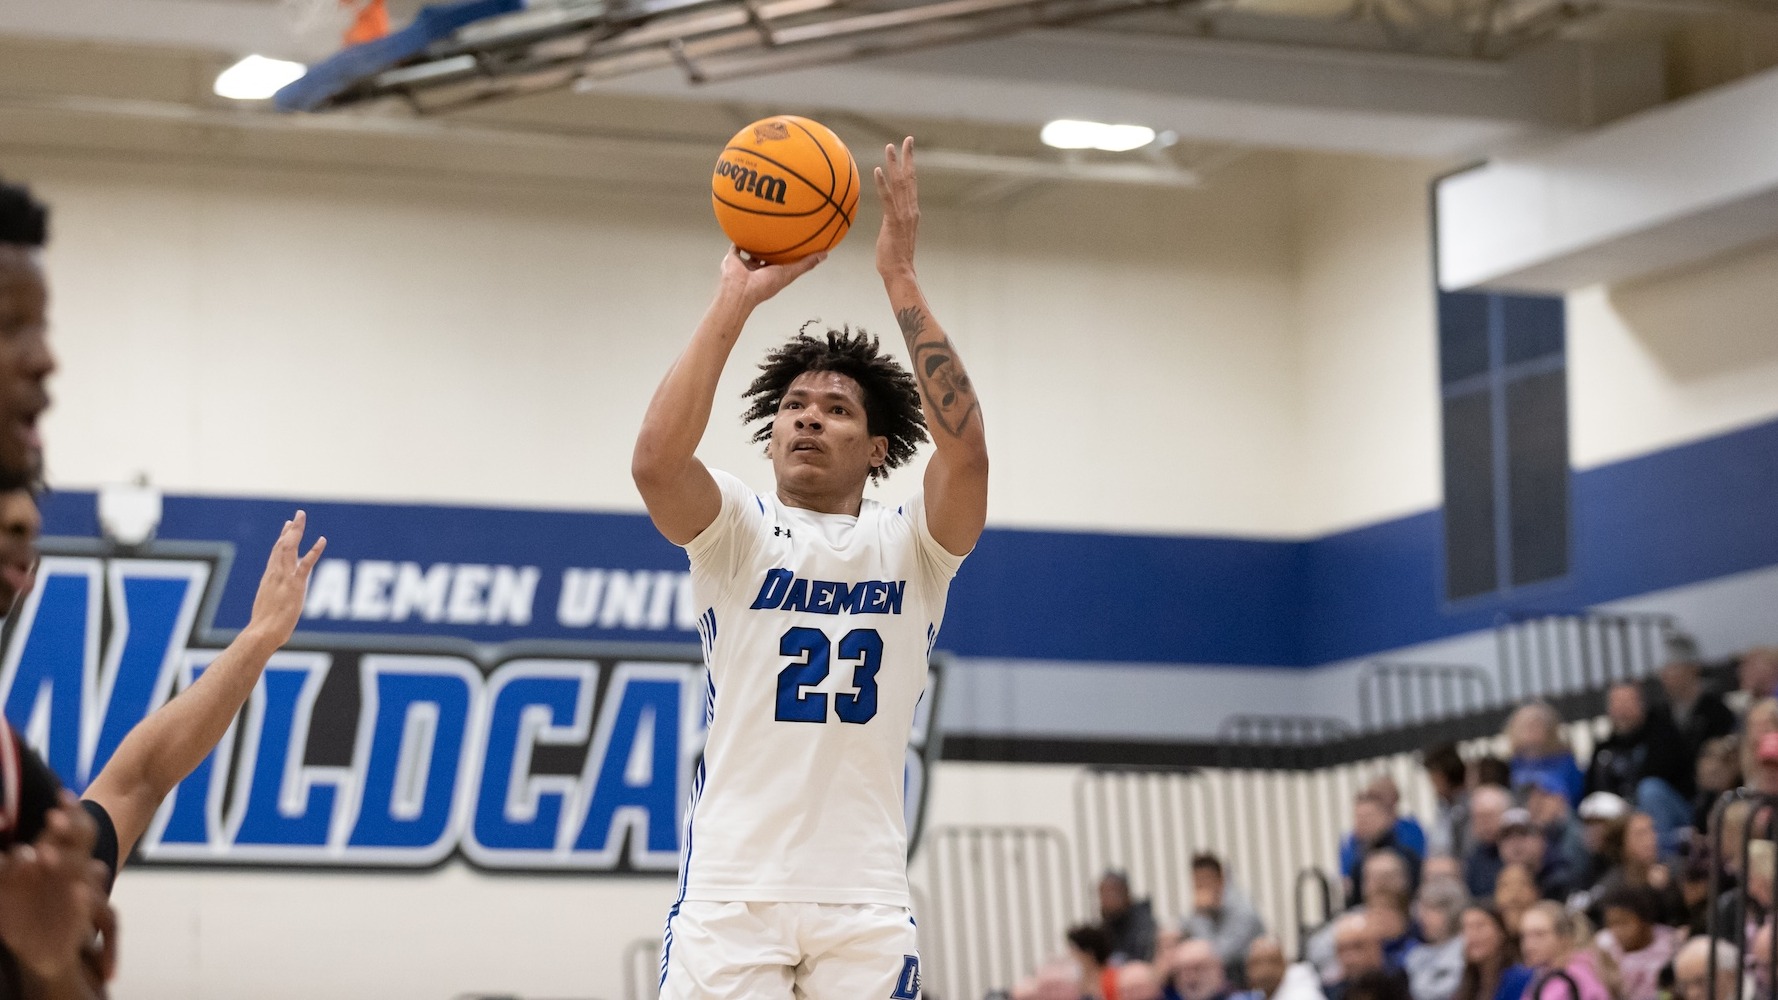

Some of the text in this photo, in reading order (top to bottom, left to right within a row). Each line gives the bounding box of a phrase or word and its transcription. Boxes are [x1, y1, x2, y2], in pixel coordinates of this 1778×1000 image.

[716, 160, 787, 205] Wilson
[302, 558, 541, 627] AEMEN
[750, 568, 906, 614] DAEMEN
[775, 626, 884, 725] 23
[0, 556, 928, 866] WILDCA
